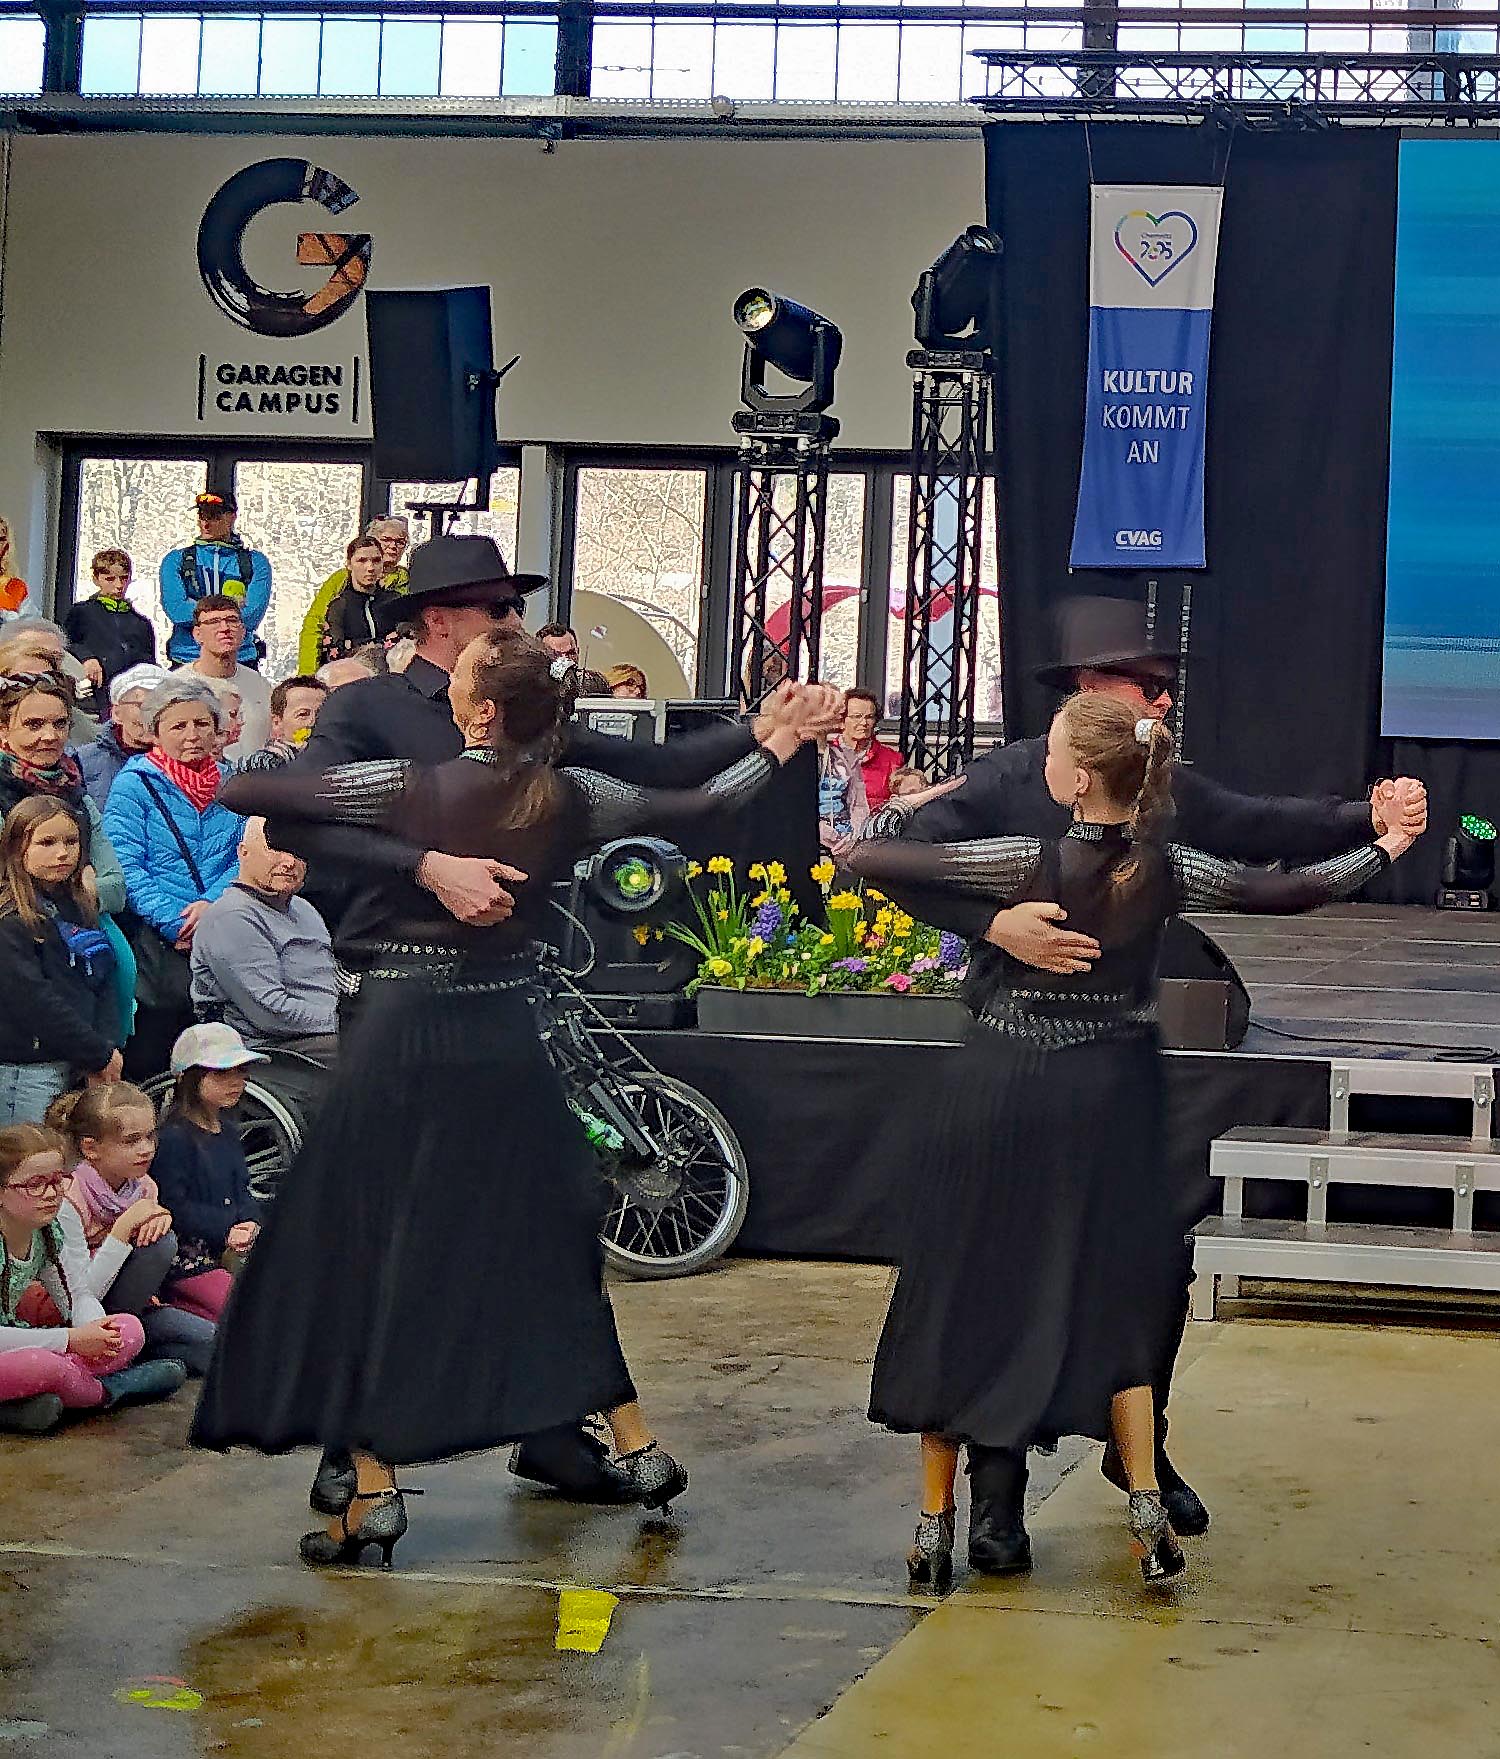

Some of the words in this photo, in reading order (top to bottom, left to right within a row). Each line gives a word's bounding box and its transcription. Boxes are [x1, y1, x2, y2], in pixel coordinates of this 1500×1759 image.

[196, 157, 372, 338] G
[215, 363, 343, 387] GARAGEN
[1103, 370, 1194, 395] KULTUR
[215, 390, 340, 414] CAMPUS
[1102, 404, 1191, 430] KOMMT
[1126, 440, 1160, 464] AN
[1115, 530, 1163, 546] CVAG
